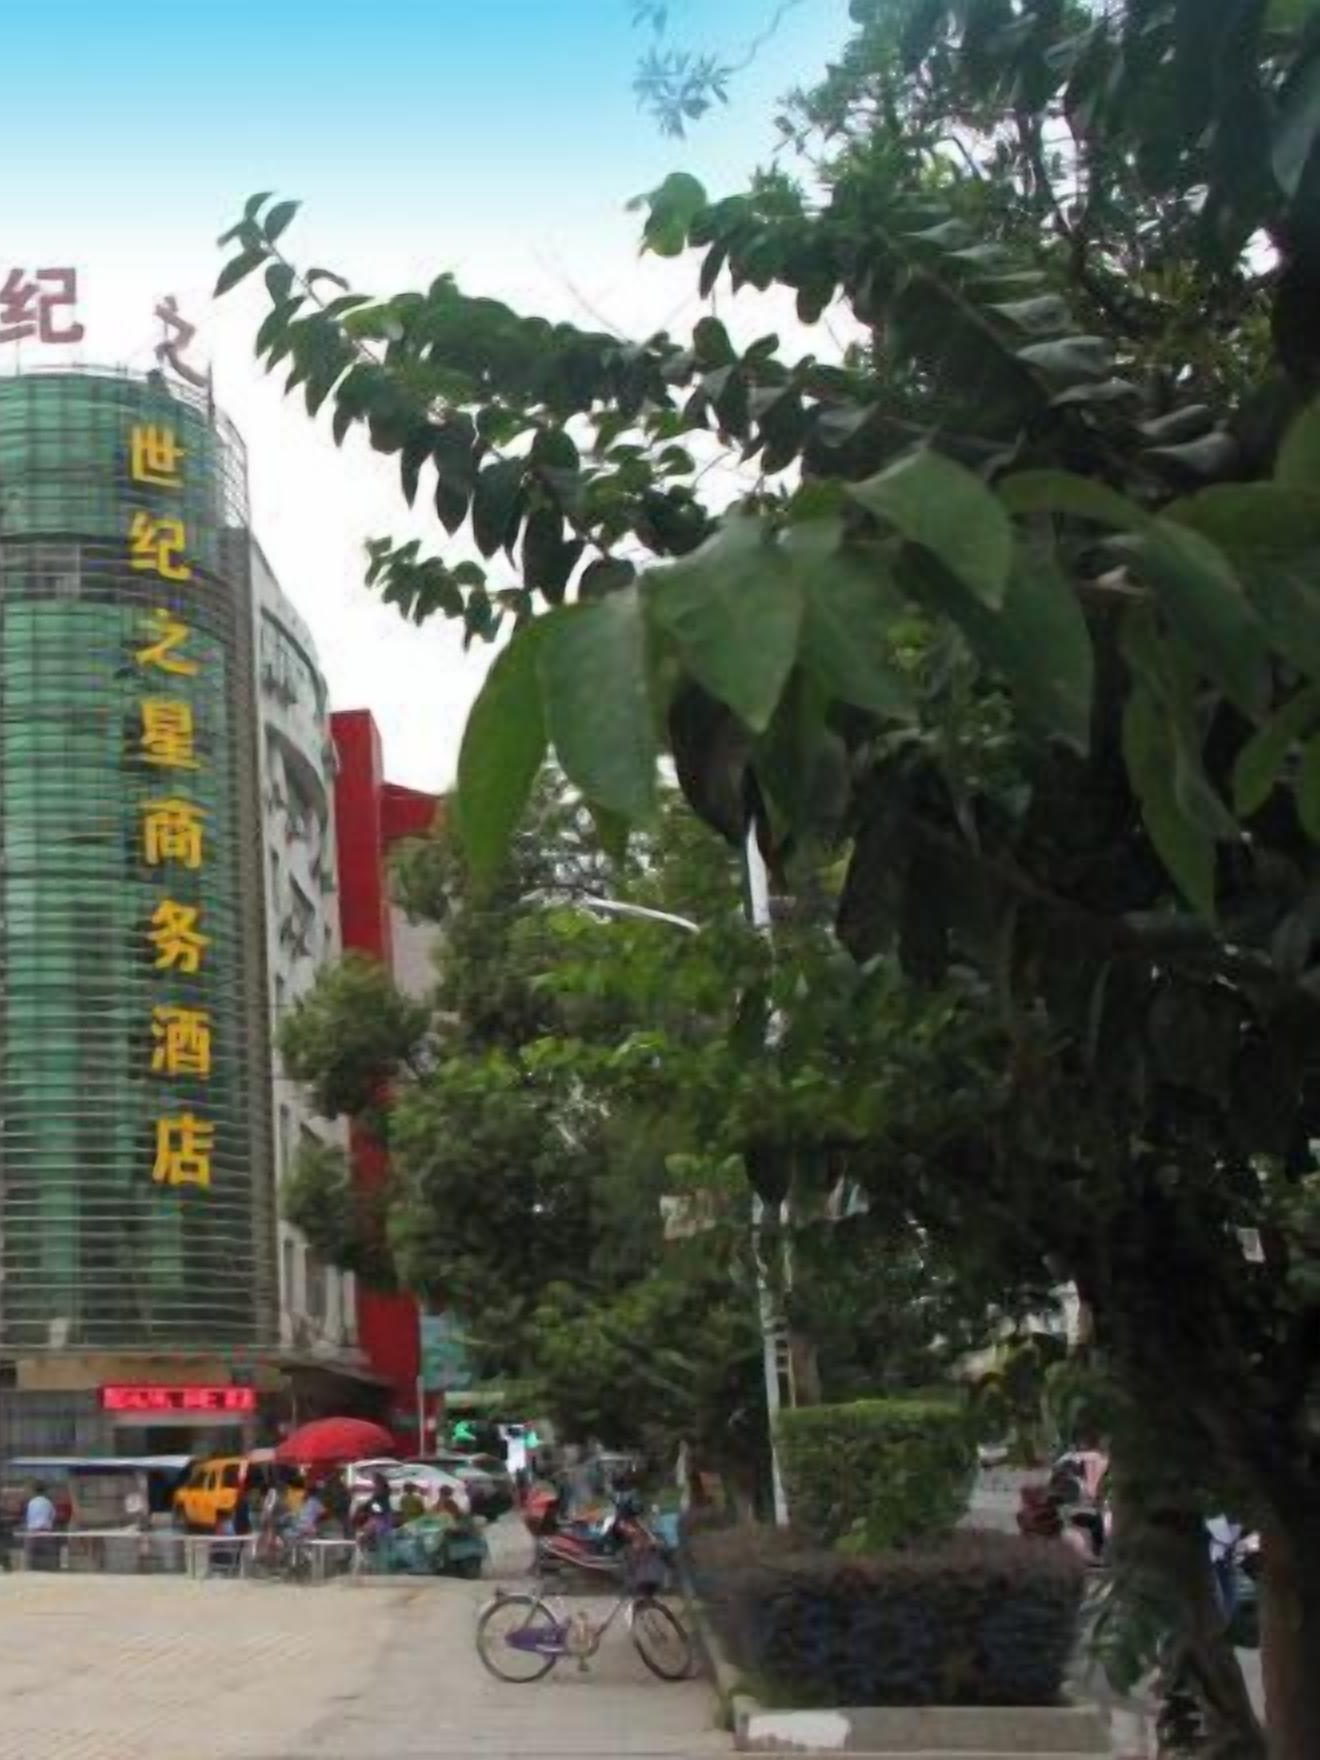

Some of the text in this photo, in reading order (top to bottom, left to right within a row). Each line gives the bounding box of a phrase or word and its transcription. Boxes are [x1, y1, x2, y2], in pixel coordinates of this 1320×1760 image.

[130, 421, 214, 1189] 世纪之星商务酒店
